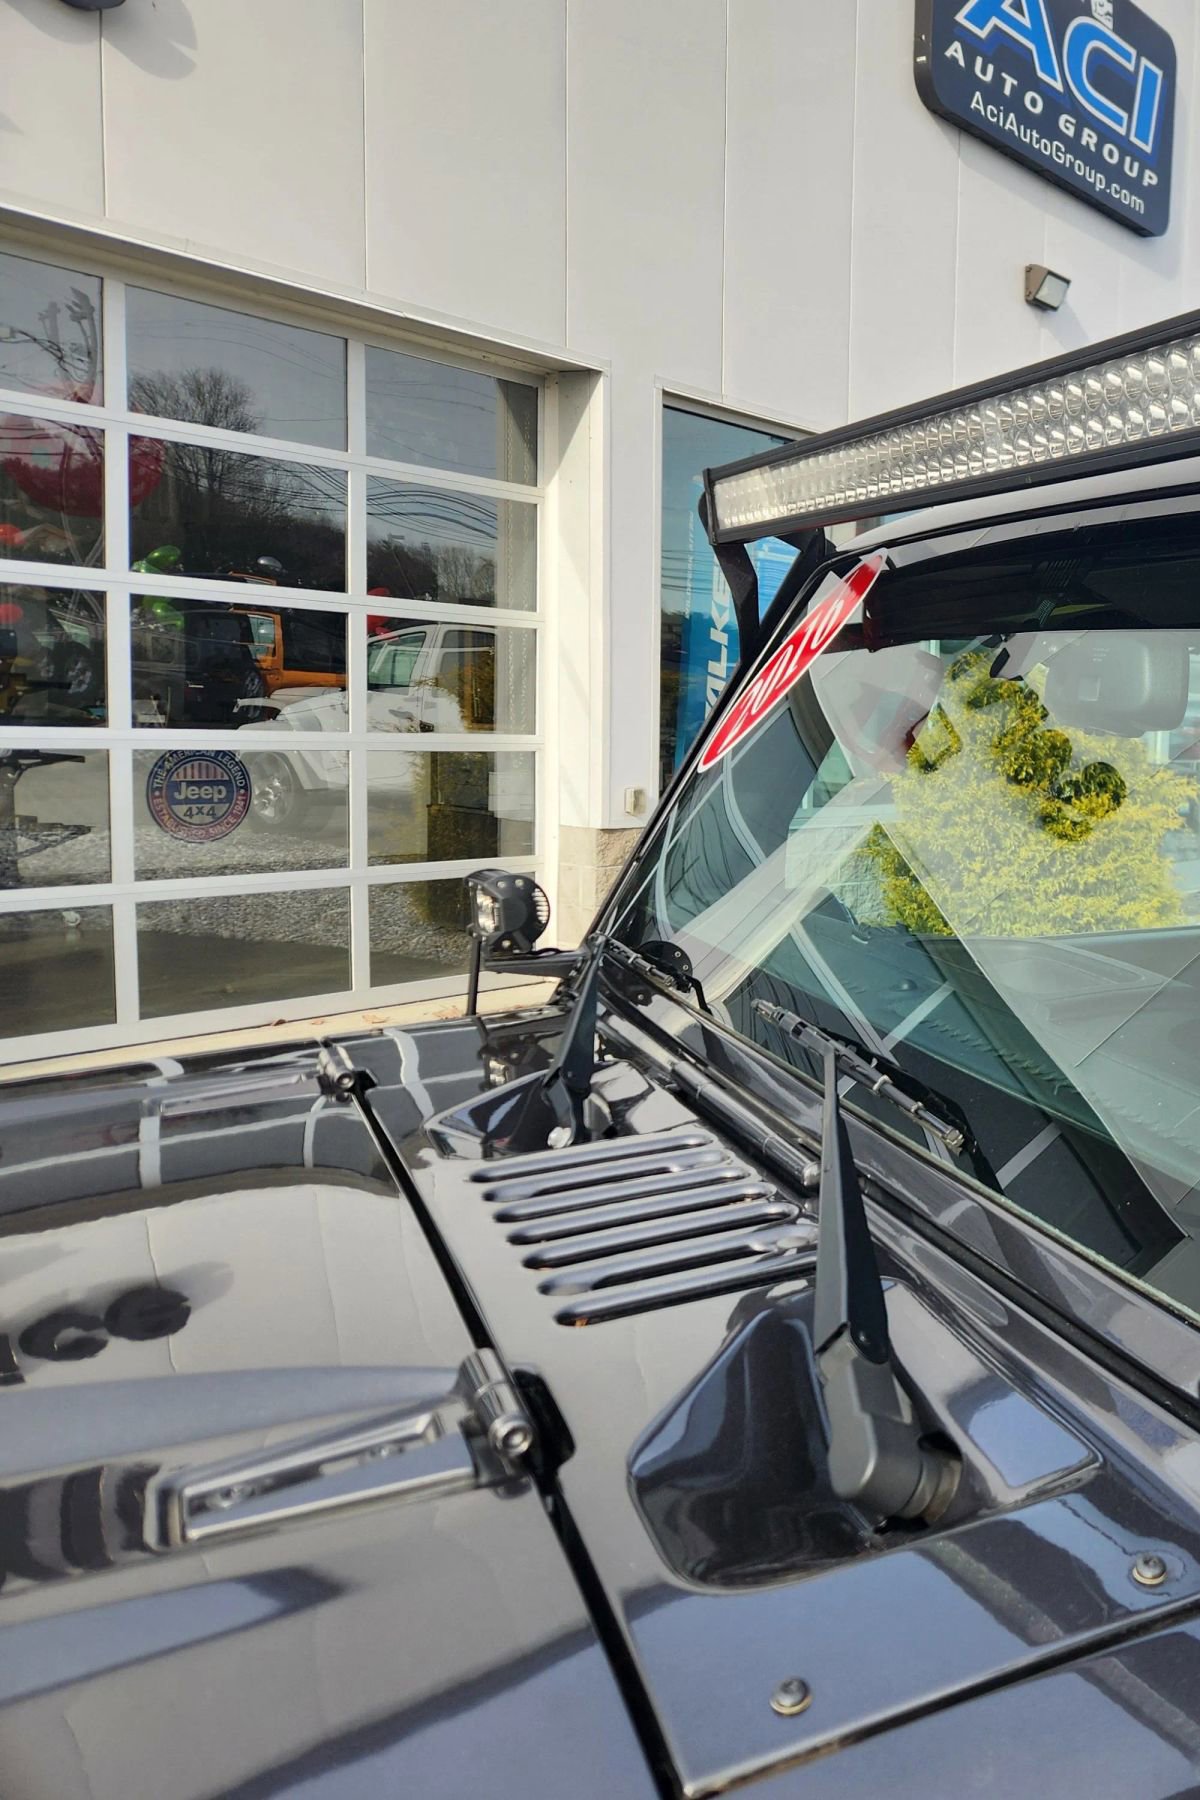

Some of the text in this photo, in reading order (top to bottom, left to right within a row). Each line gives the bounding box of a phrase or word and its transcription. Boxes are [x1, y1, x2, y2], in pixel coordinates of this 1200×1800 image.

[944, 40, 1159, 187] AUTO GROUP
[954, 0, 1164, 154] ACI
[970, 90, 1145, 214] AciAutoGroup.com
[153, 767, 167, 788] THE
[218, 751, 246, 787] LEGEND
[174, 782, 227, 802] Jeep
[208, 814, 237, 837] SINCE
[233, 795, 247, 816] 1941
